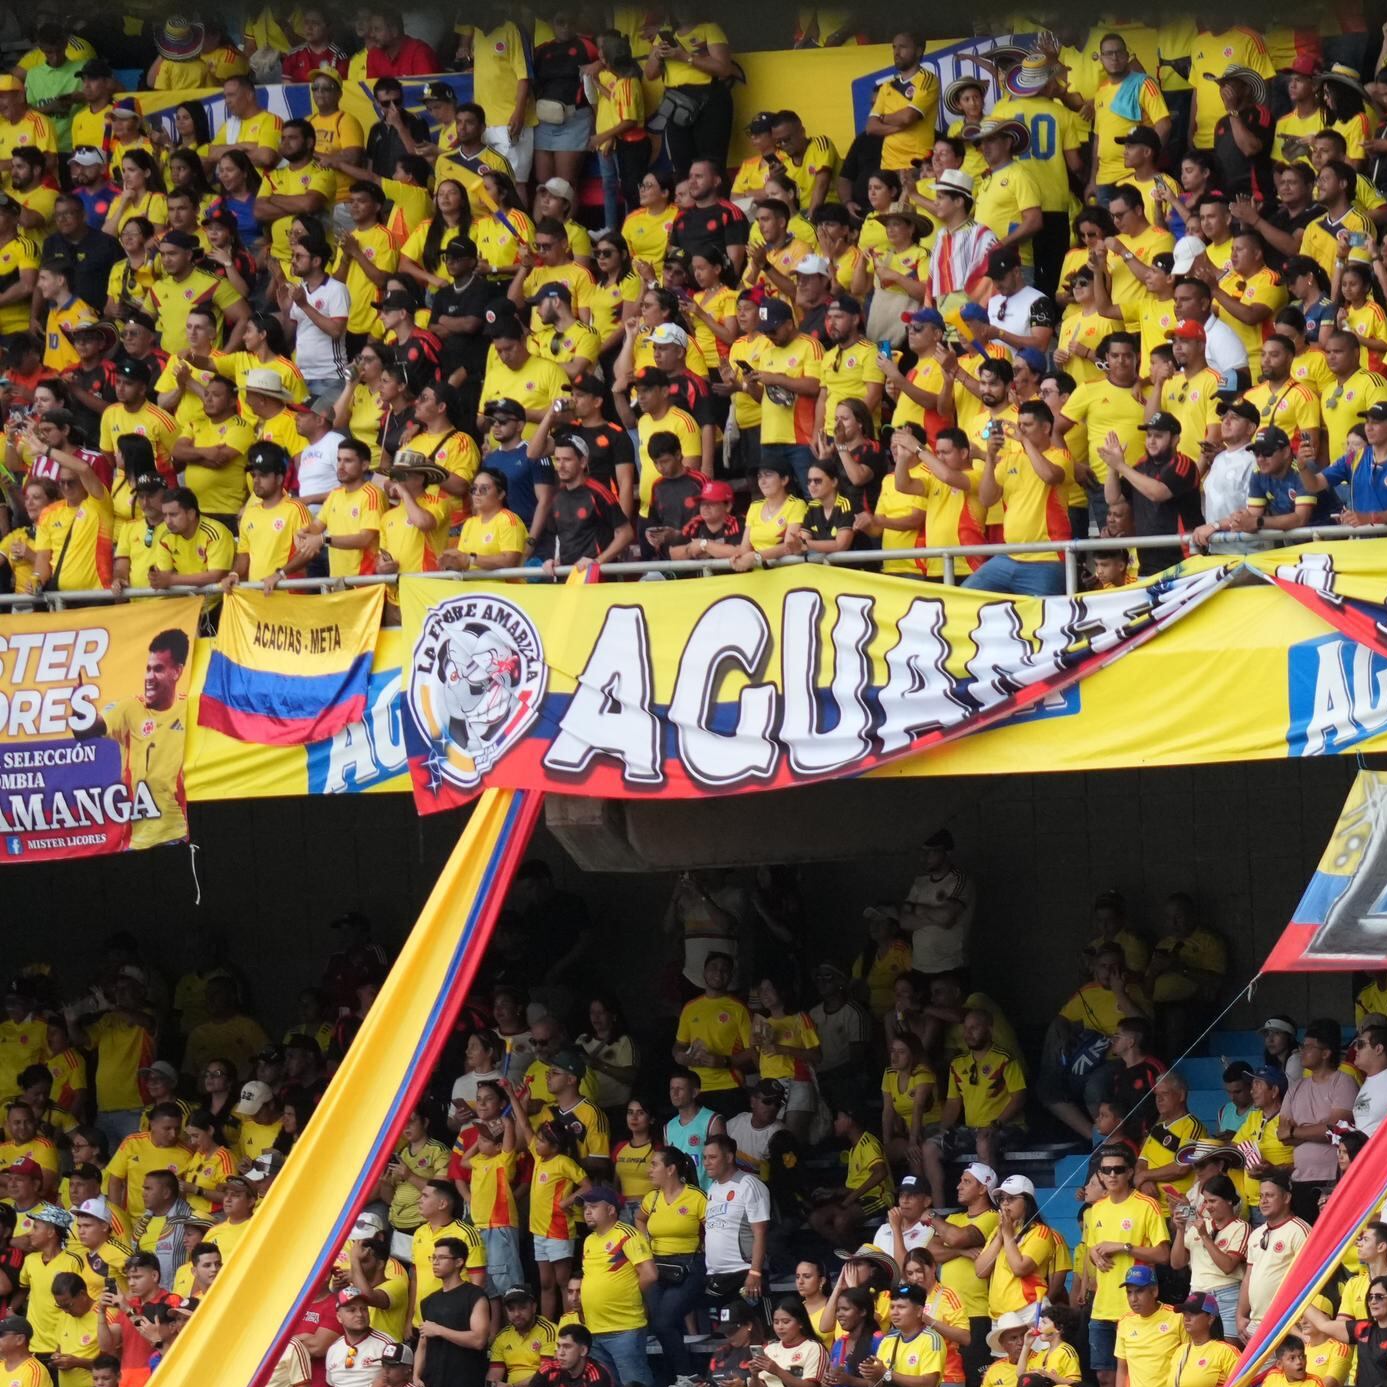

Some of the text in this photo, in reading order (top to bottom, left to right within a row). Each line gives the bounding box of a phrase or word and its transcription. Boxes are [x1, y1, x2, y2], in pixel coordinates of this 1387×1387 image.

[254, 621, 342, 656] ACACIAS META
[5, 744, 97, 768] SELECCIÓN
[28, 833, 107, 850] MISTER LICORES
